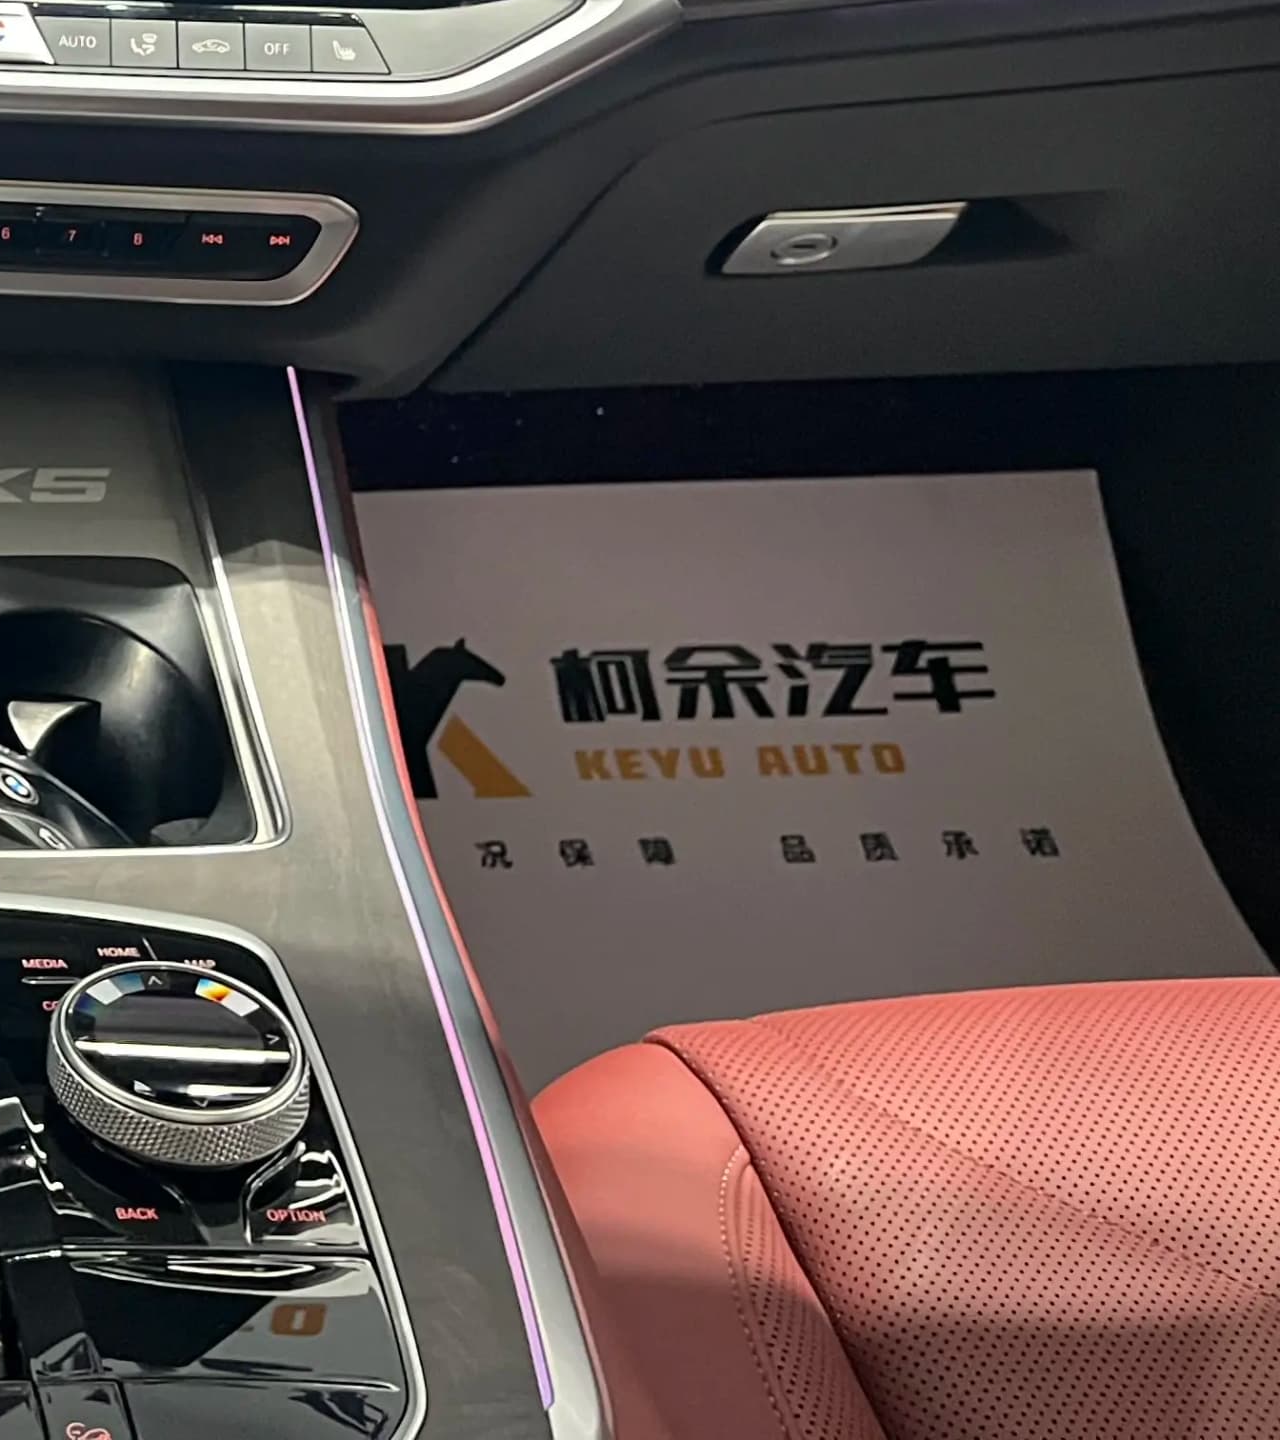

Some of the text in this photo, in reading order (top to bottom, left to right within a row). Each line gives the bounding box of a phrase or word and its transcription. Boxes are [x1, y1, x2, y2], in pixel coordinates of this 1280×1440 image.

[58, 34, 97, 49] AUTO
[264, 42, 290, 56] OFF
[1, 227, 10, 239] 6
[68, 229, 77, 242] 7
[133, 233, 143, 246] 8
[549, 640, 996, 723] 柯余汽车
[573, 742, 908, 781] KEYU AUTO
[779, 827, 1060, 863] 品质承诺
[97, 946, 141, 957] HOME
[22, 958, 68, 970] MEDIA
[115, 1208, 159, 1220] BACK
[266, 1209, 326, 1223] OPTION
